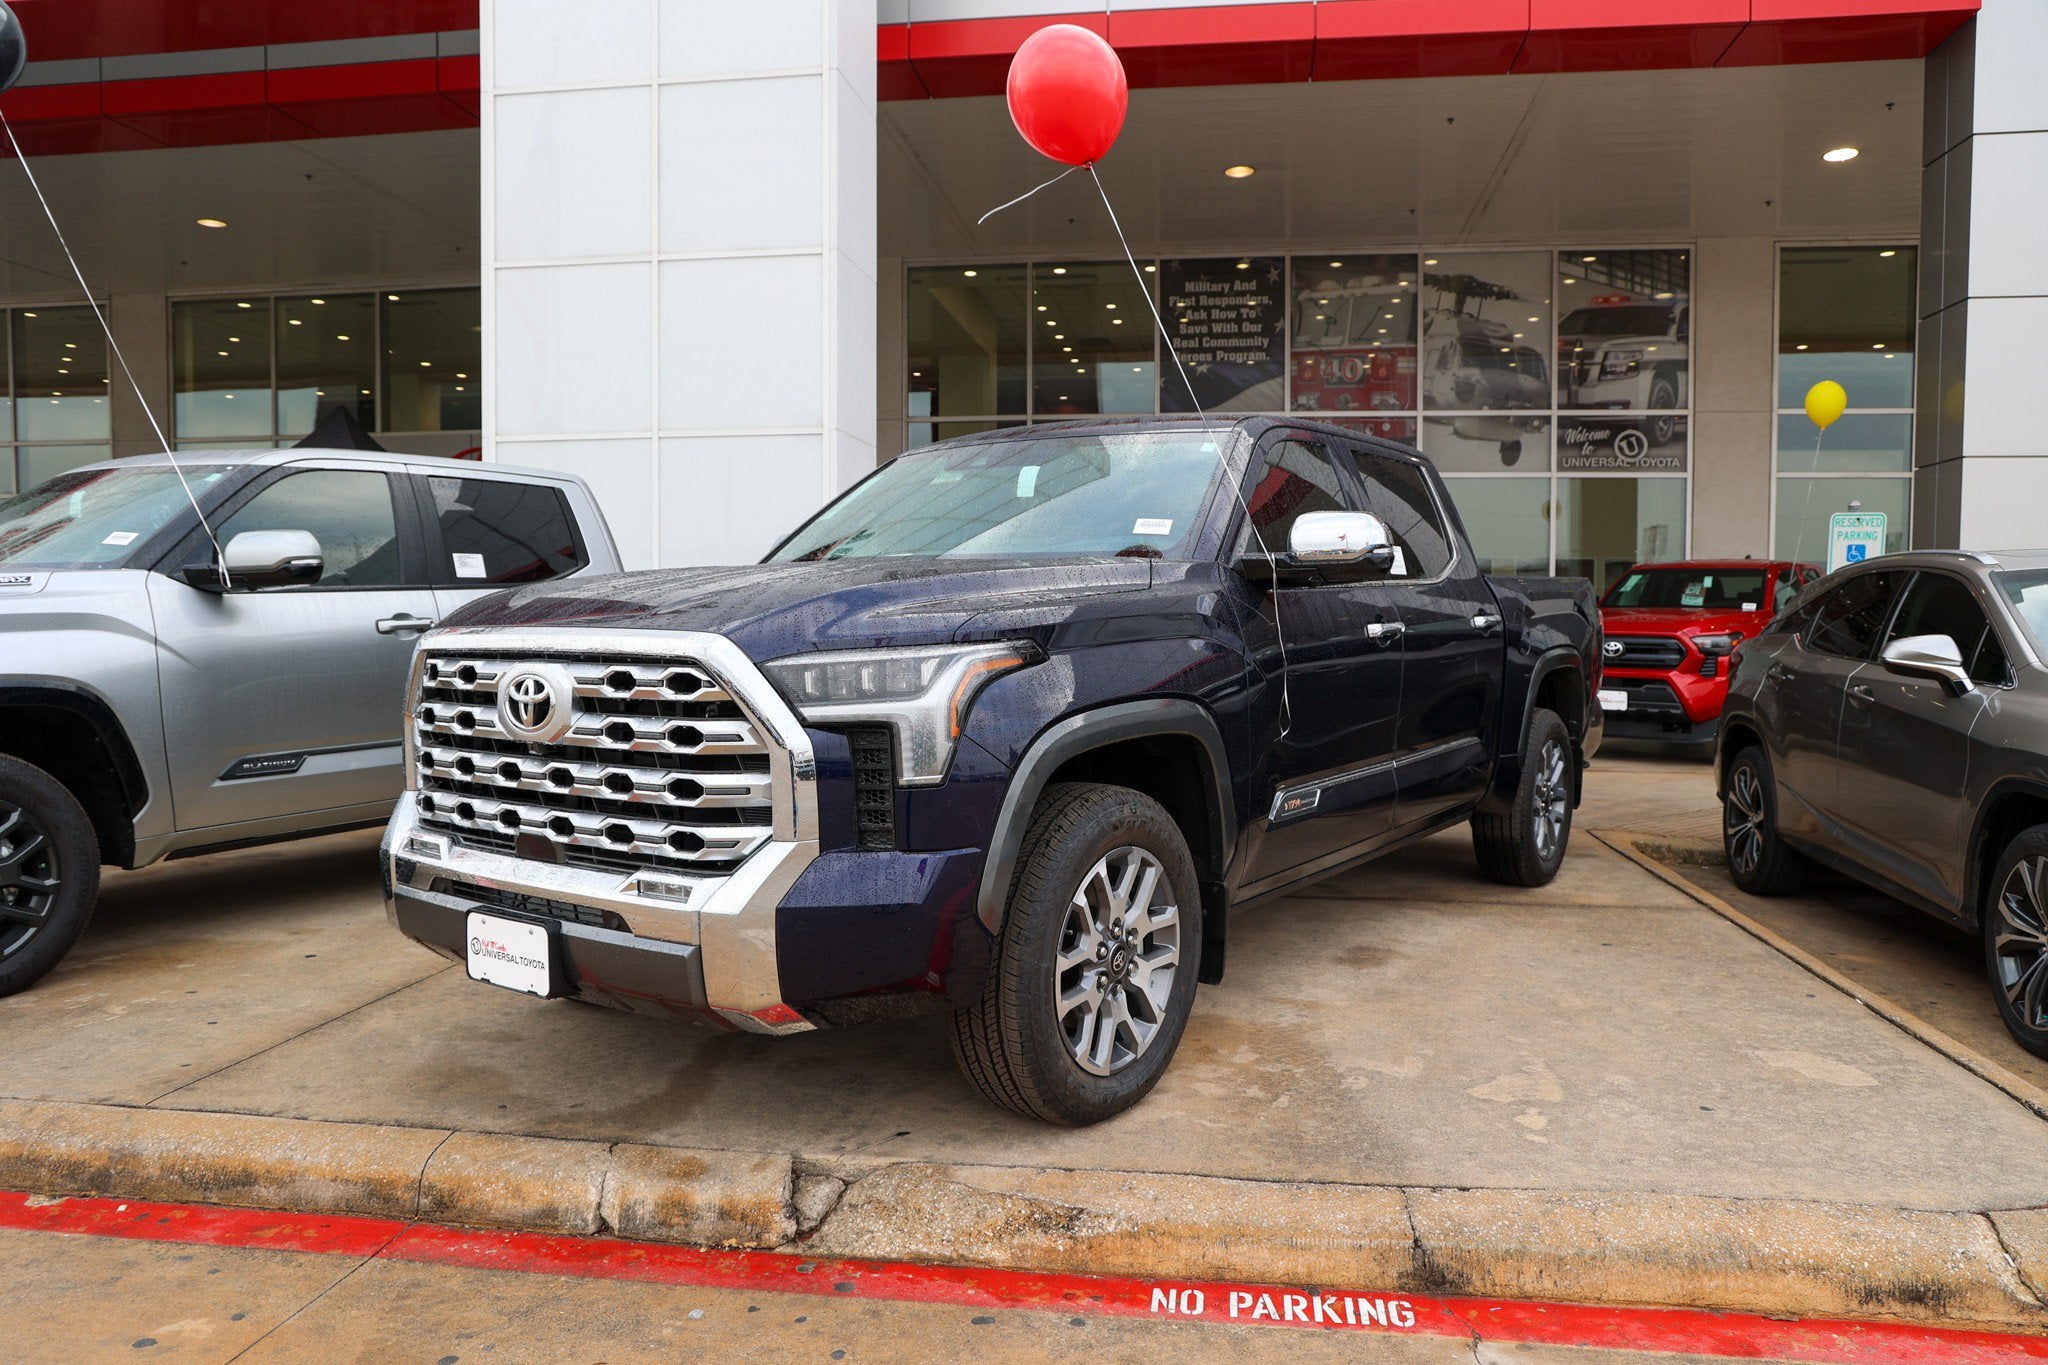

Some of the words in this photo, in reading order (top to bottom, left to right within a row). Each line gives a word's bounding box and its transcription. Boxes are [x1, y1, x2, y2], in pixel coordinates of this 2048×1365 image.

[1184, 281, 1230, 293] Military
[1233, 279, 1257, 291] And
[1169, 295, 1196, 307] First
[1199, 294, 1272, 308] Responders,
[1186, 309, 1207, 320] Ask
[1211, 308, 1237, 319] How
[1241, 307, 1256, 318] To
[1179, 323, 1208, 334] Save
[1212, 322, 1238, 333] With
[1242, 321, 1262, 333] Our
[1172, 337, 1199, 348] Real
[1202, 335, 1269, 348] Community
[1216, 350, 1270, 363] Program.
[1321, 356, 1362, 382] 40
[1564, 426, 1611, 444] Welcome
[1581, 441, 1596, 455] to
[1562, 457, 1631, 467] UNIVERSAL
[1635, 457, 1680, 467] TOYOTA
[1835, 517, 1883, 527] RESERVED
[1837, 531, 1878, 541] PARKING
[481, 948, 519, 965] UNIVERSAL
[520, 956, 546, 971] TOYOTA
[1150, 1288, 1204, 1315] NO
[1229, 1291, 1416, 1328] PARKING
